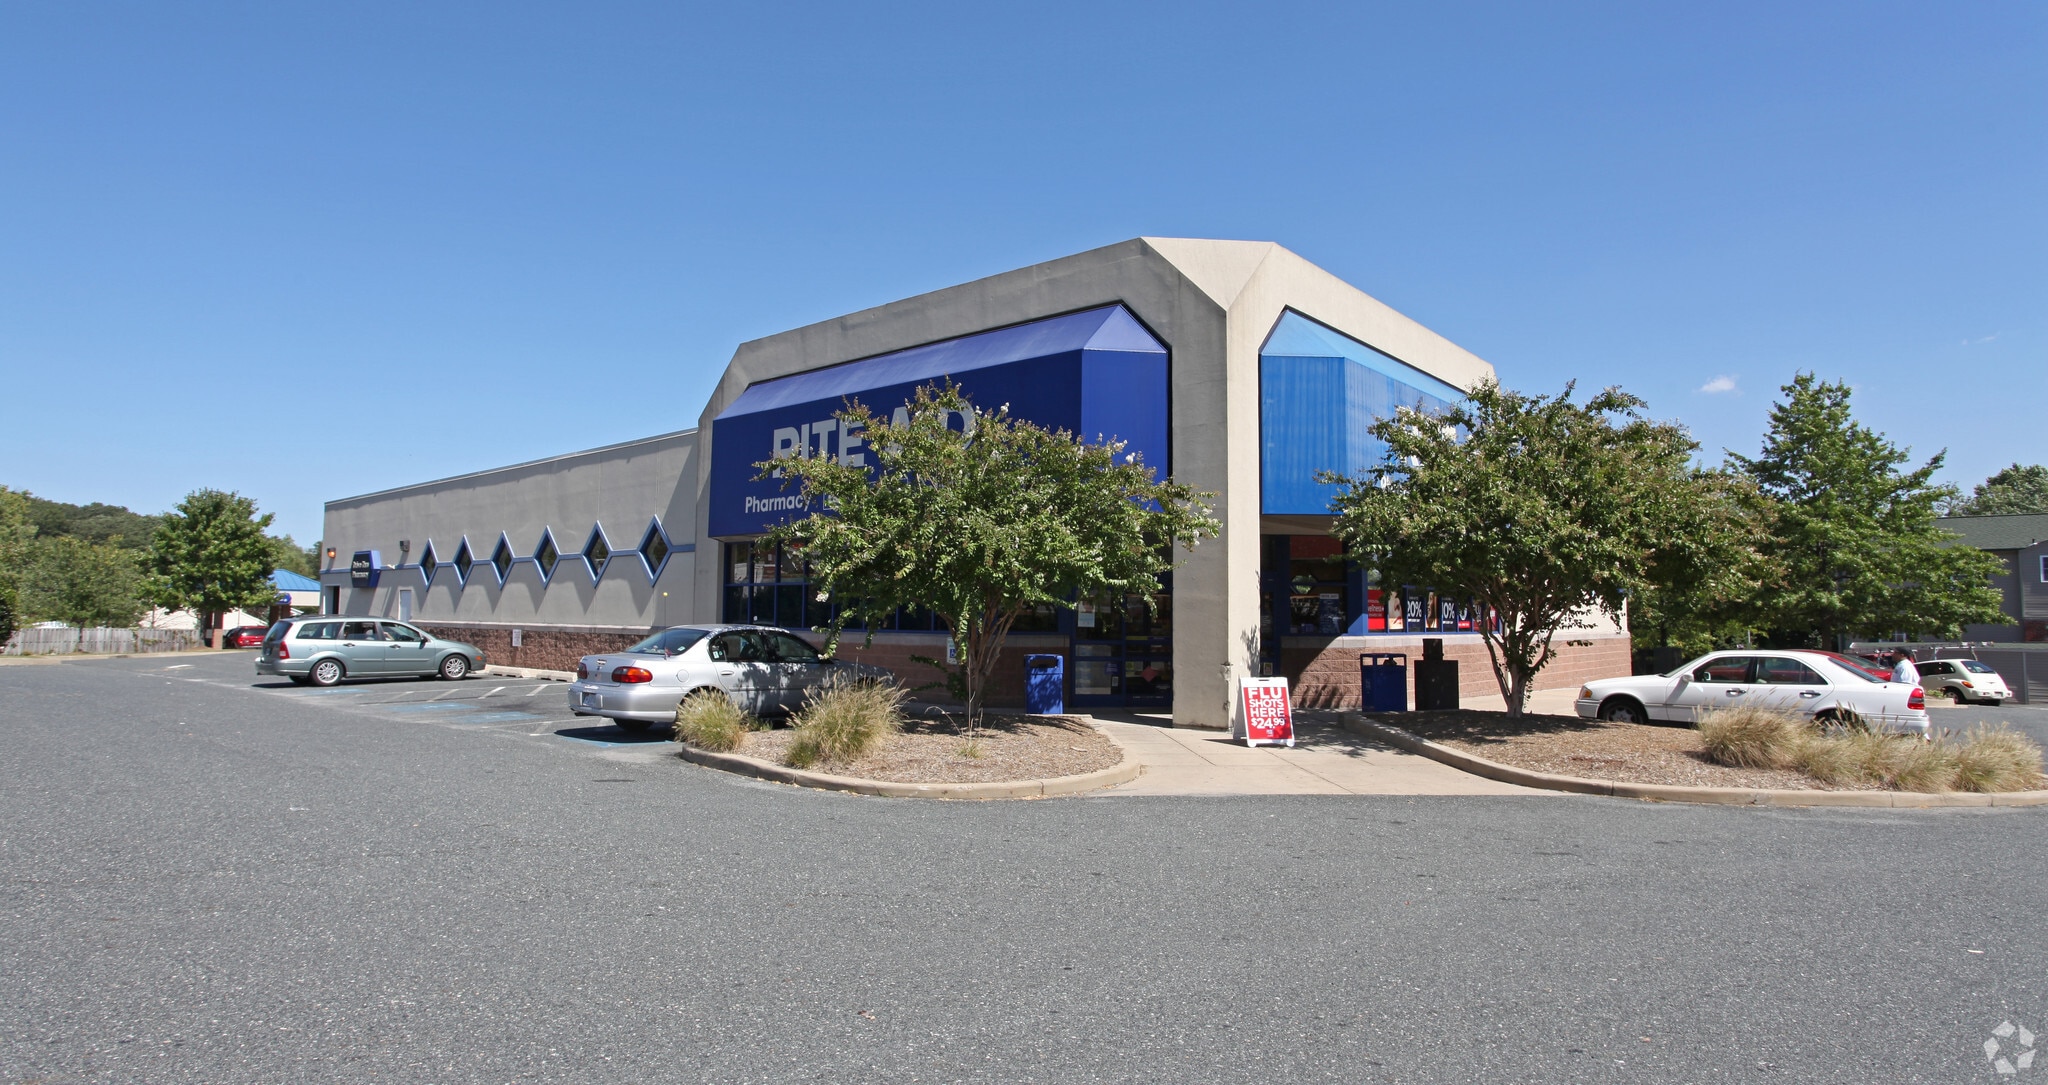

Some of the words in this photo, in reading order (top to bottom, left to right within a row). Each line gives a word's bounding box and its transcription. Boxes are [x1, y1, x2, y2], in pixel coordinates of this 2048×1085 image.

[744, 494, 812, 514] Pharmacy
[1248, 687, 1282, 699] FLU
[1249, 698, 1284, 708] SHOTS
[1250, 707, 1285, 717] HERE
